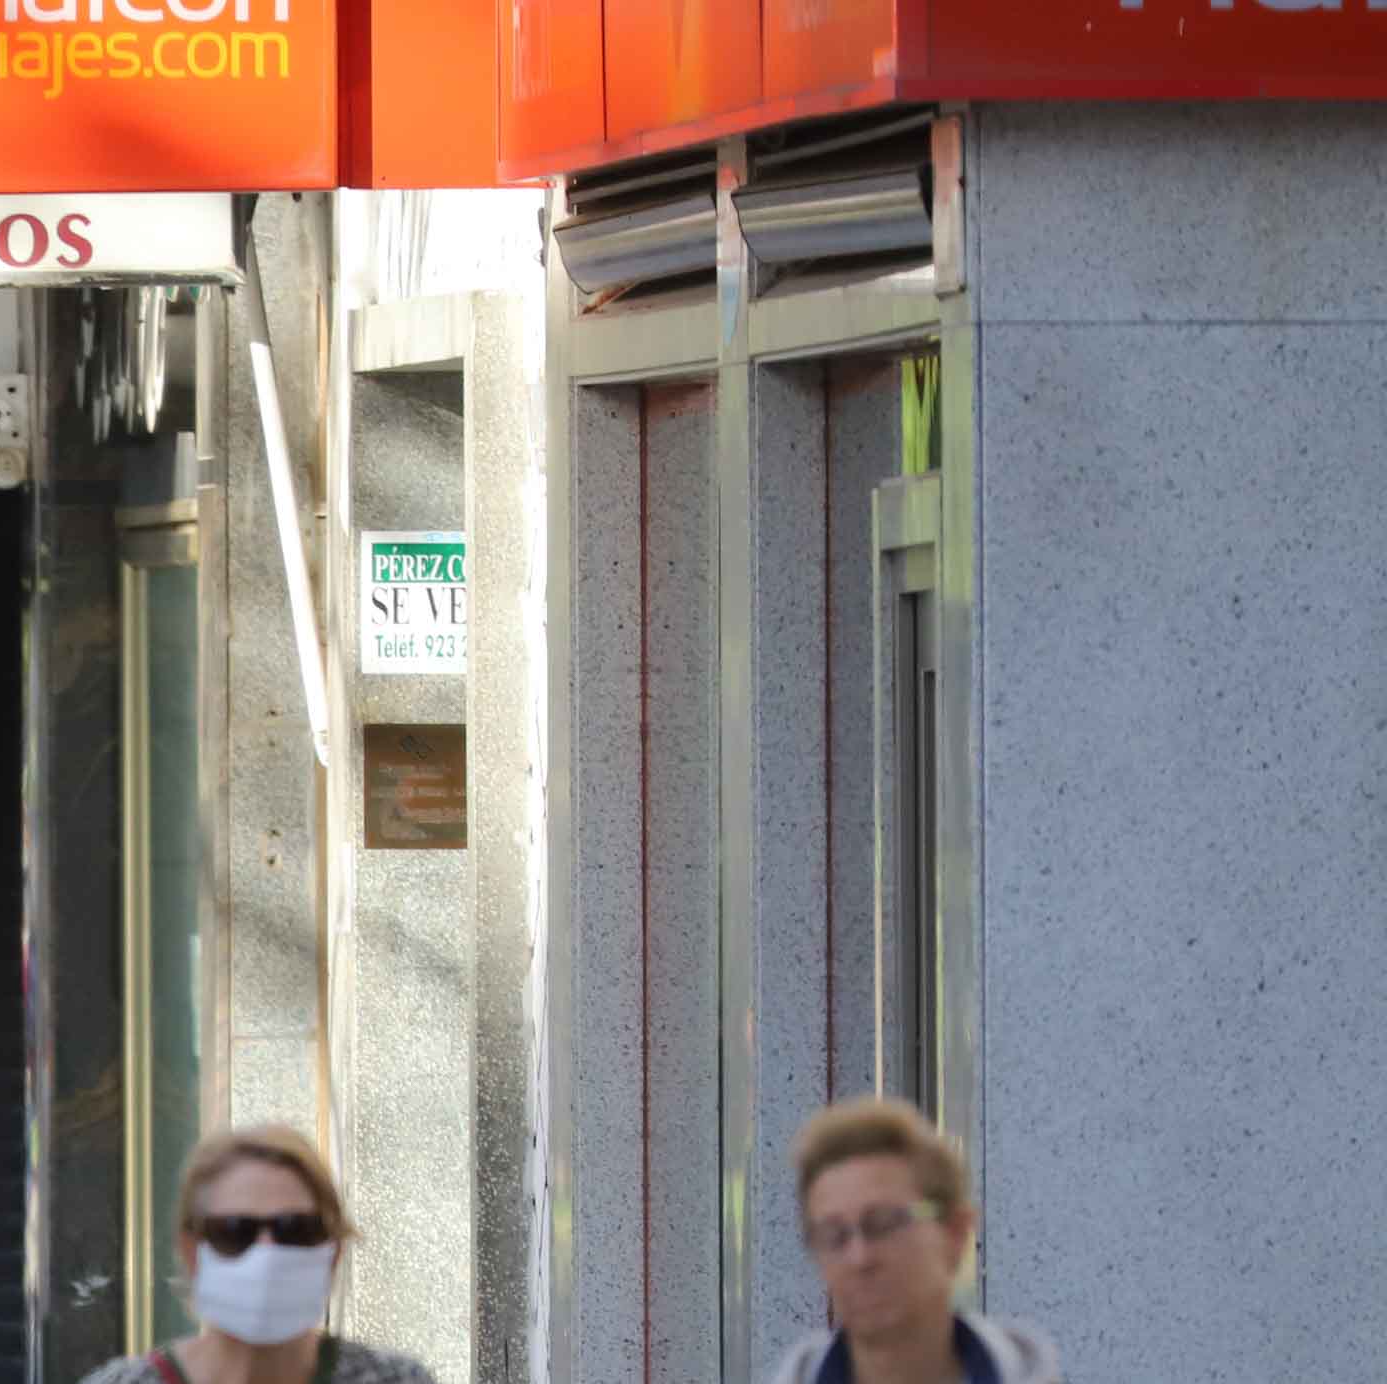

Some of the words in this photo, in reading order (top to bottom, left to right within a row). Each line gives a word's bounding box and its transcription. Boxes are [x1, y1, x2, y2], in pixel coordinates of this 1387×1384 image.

[374, 545, 443, 581] PÉREZ
[371, 586, 410, 625] SE
[425, 634, 455, 658] 923
